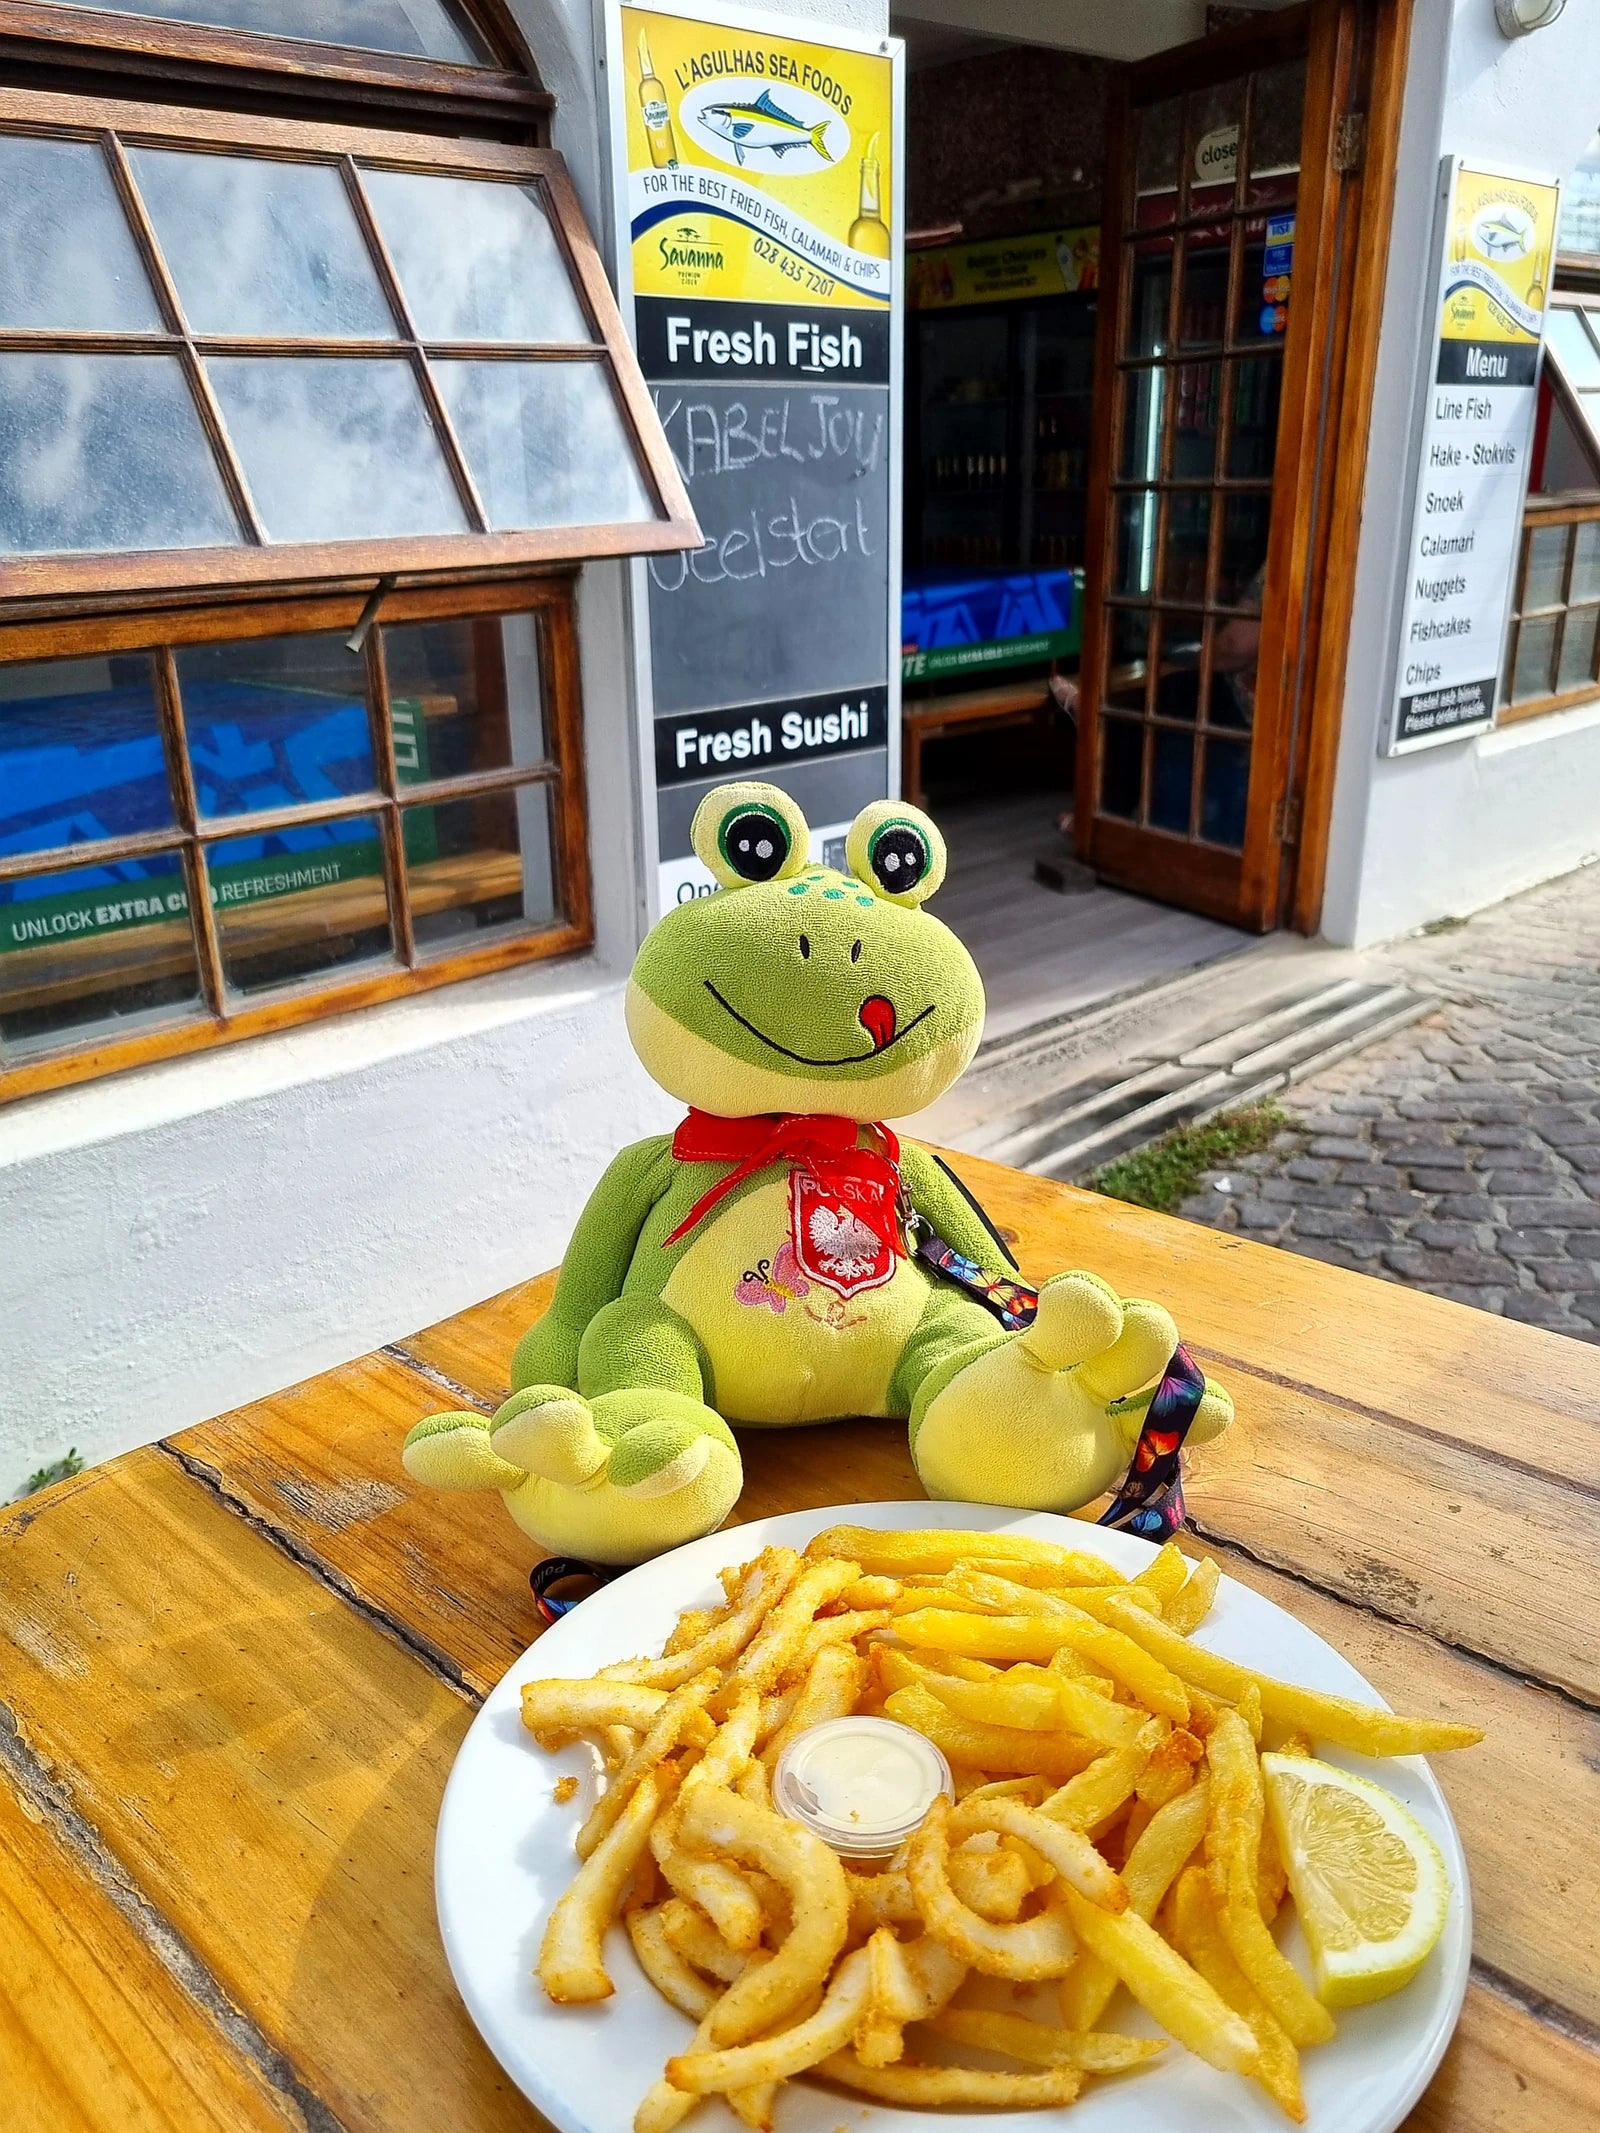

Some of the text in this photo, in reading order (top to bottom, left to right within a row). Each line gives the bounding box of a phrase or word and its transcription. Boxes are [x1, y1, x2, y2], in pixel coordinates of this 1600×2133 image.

[675, 49, 853, 116] L'AGULHAS SEA FOODS
[643, 174, 881, 280] FOR THE BEST FRIED FISH, CALAMARI & CHIPS
[659, 236, 724, 272] Savanna
[753, 237, 836, 298] 028 435 7207
[666, 316, 863, 368] Fresh Fish
[1466, 347, 1508, 378] Menu
[1436, 397, 1492, 420] Line Fish
[1430, 445, 1461, 467] Hake
[1472, 442, 1516, 465] Stokvis
[1425, 489, 1464, 514] Snoek
[1421, 529, 1475, 557] Calamari
[1415, 572, 1466, 602] Nuggets
[1410, 616, 1471, 643] Fishcakes
[1406, 661, 1441, 685] Chips
[675, 700, 869, 768] Fresh Sushi
[12, 862, 341, 941] UNLOCK EXTRA CD REFRESHMENT
